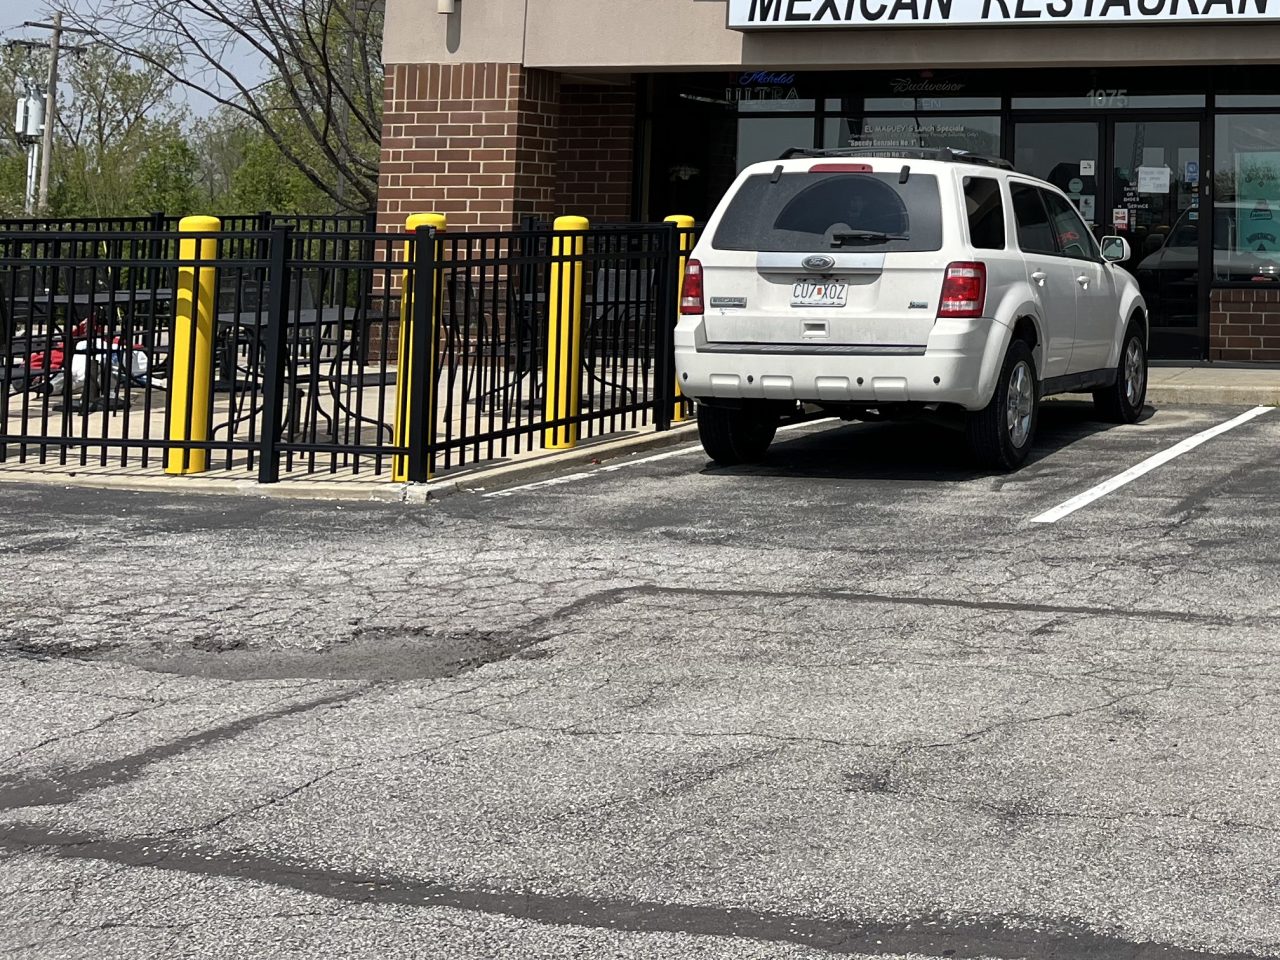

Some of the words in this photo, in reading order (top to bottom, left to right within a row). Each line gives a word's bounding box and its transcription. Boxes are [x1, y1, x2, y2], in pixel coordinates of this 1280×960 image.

[739, 70, 796, 86] Michelob
[888, 78, 966, 93] Budweiser
[725, 86, 800, 105] ULTRA
[1086, 89, 1128, 108] 1075
[793, 283, 816, 298] CU7
